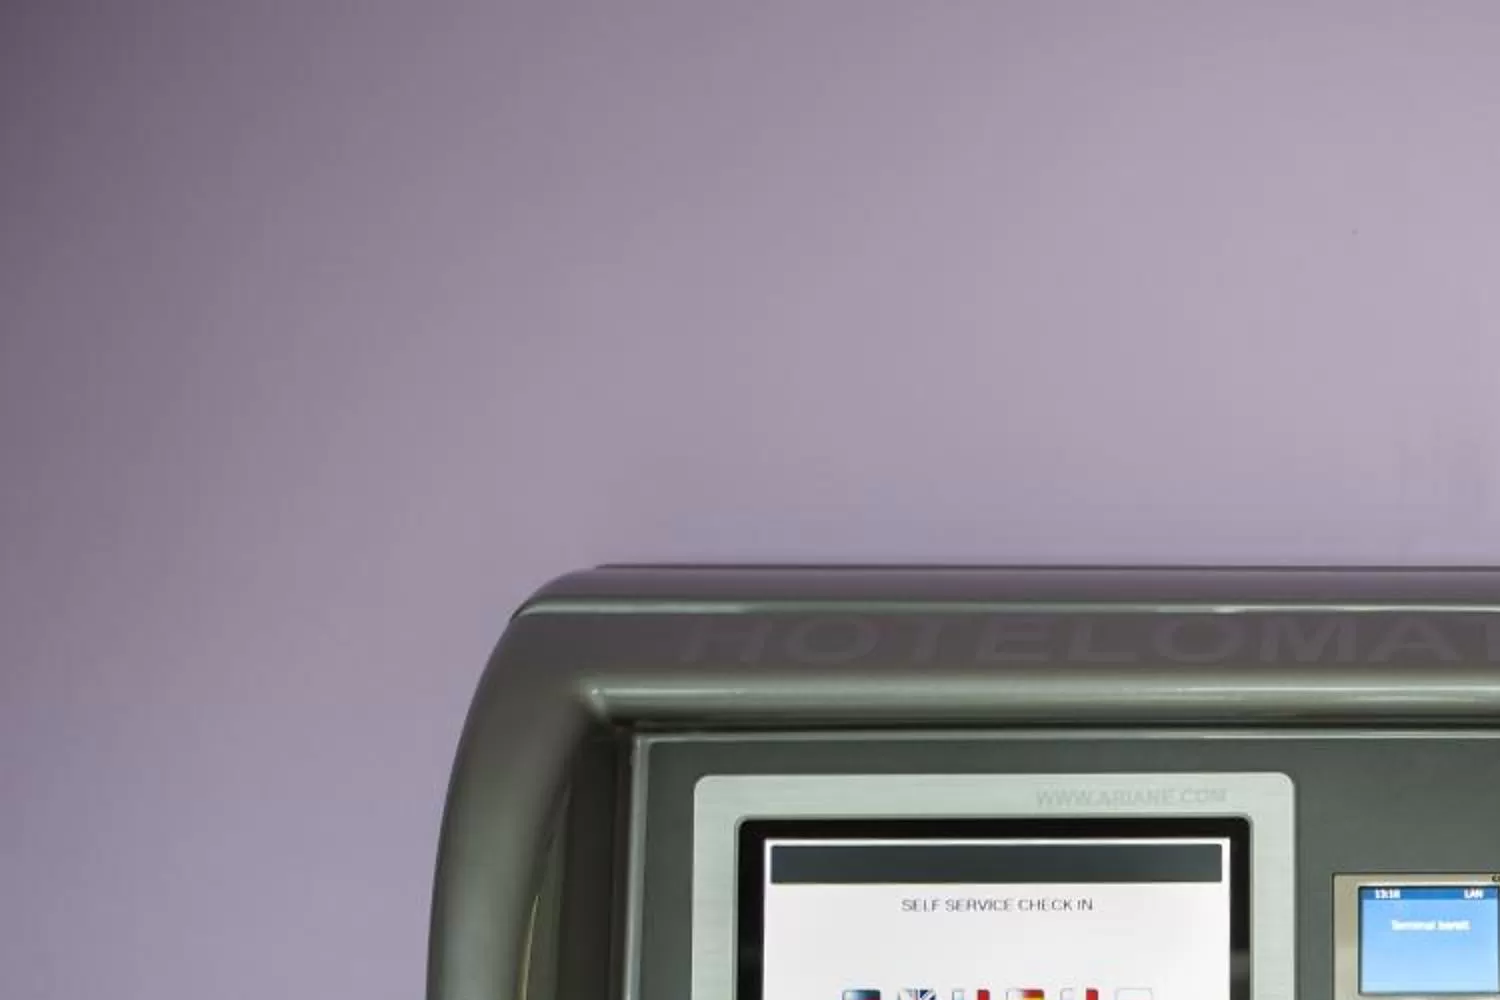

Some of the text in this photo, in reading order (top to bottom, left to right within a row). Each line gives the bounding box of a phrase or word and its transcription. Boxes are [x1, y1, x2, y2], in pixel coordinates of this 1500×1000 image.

[901, 898, 1094, 912] SELF SERVICE CHECK IN
